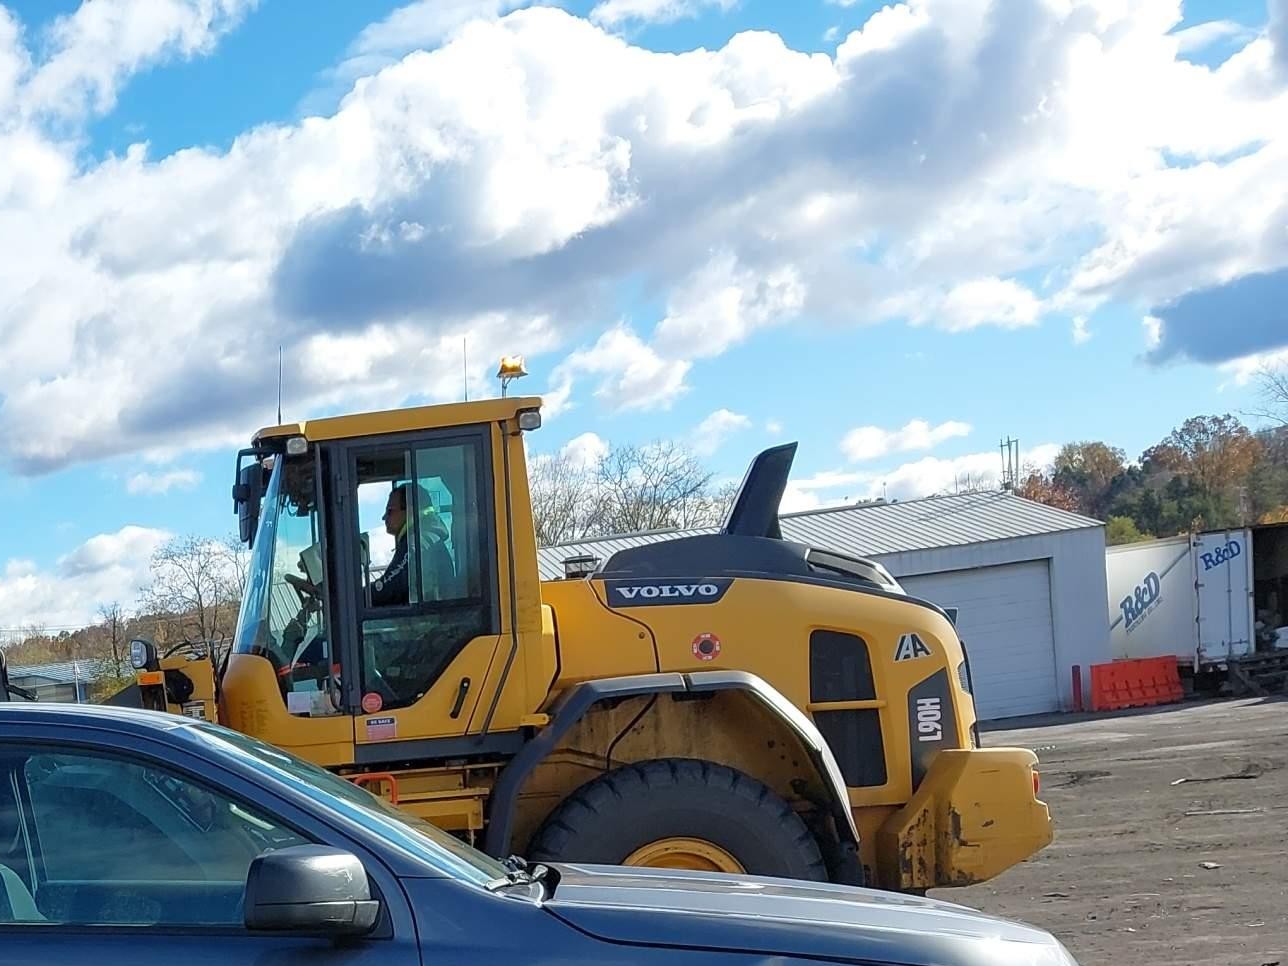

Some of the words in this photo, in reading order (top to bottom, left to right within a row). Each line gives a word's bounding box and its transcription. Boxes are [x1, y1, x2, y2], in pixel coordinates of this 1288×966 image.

[1199, 540, 1241, 571] R&D
[615, 584, 719, 599] VOLVO
[1119, 571, 1160, 629] R&D
[916, 697, 943, 742] L90H
